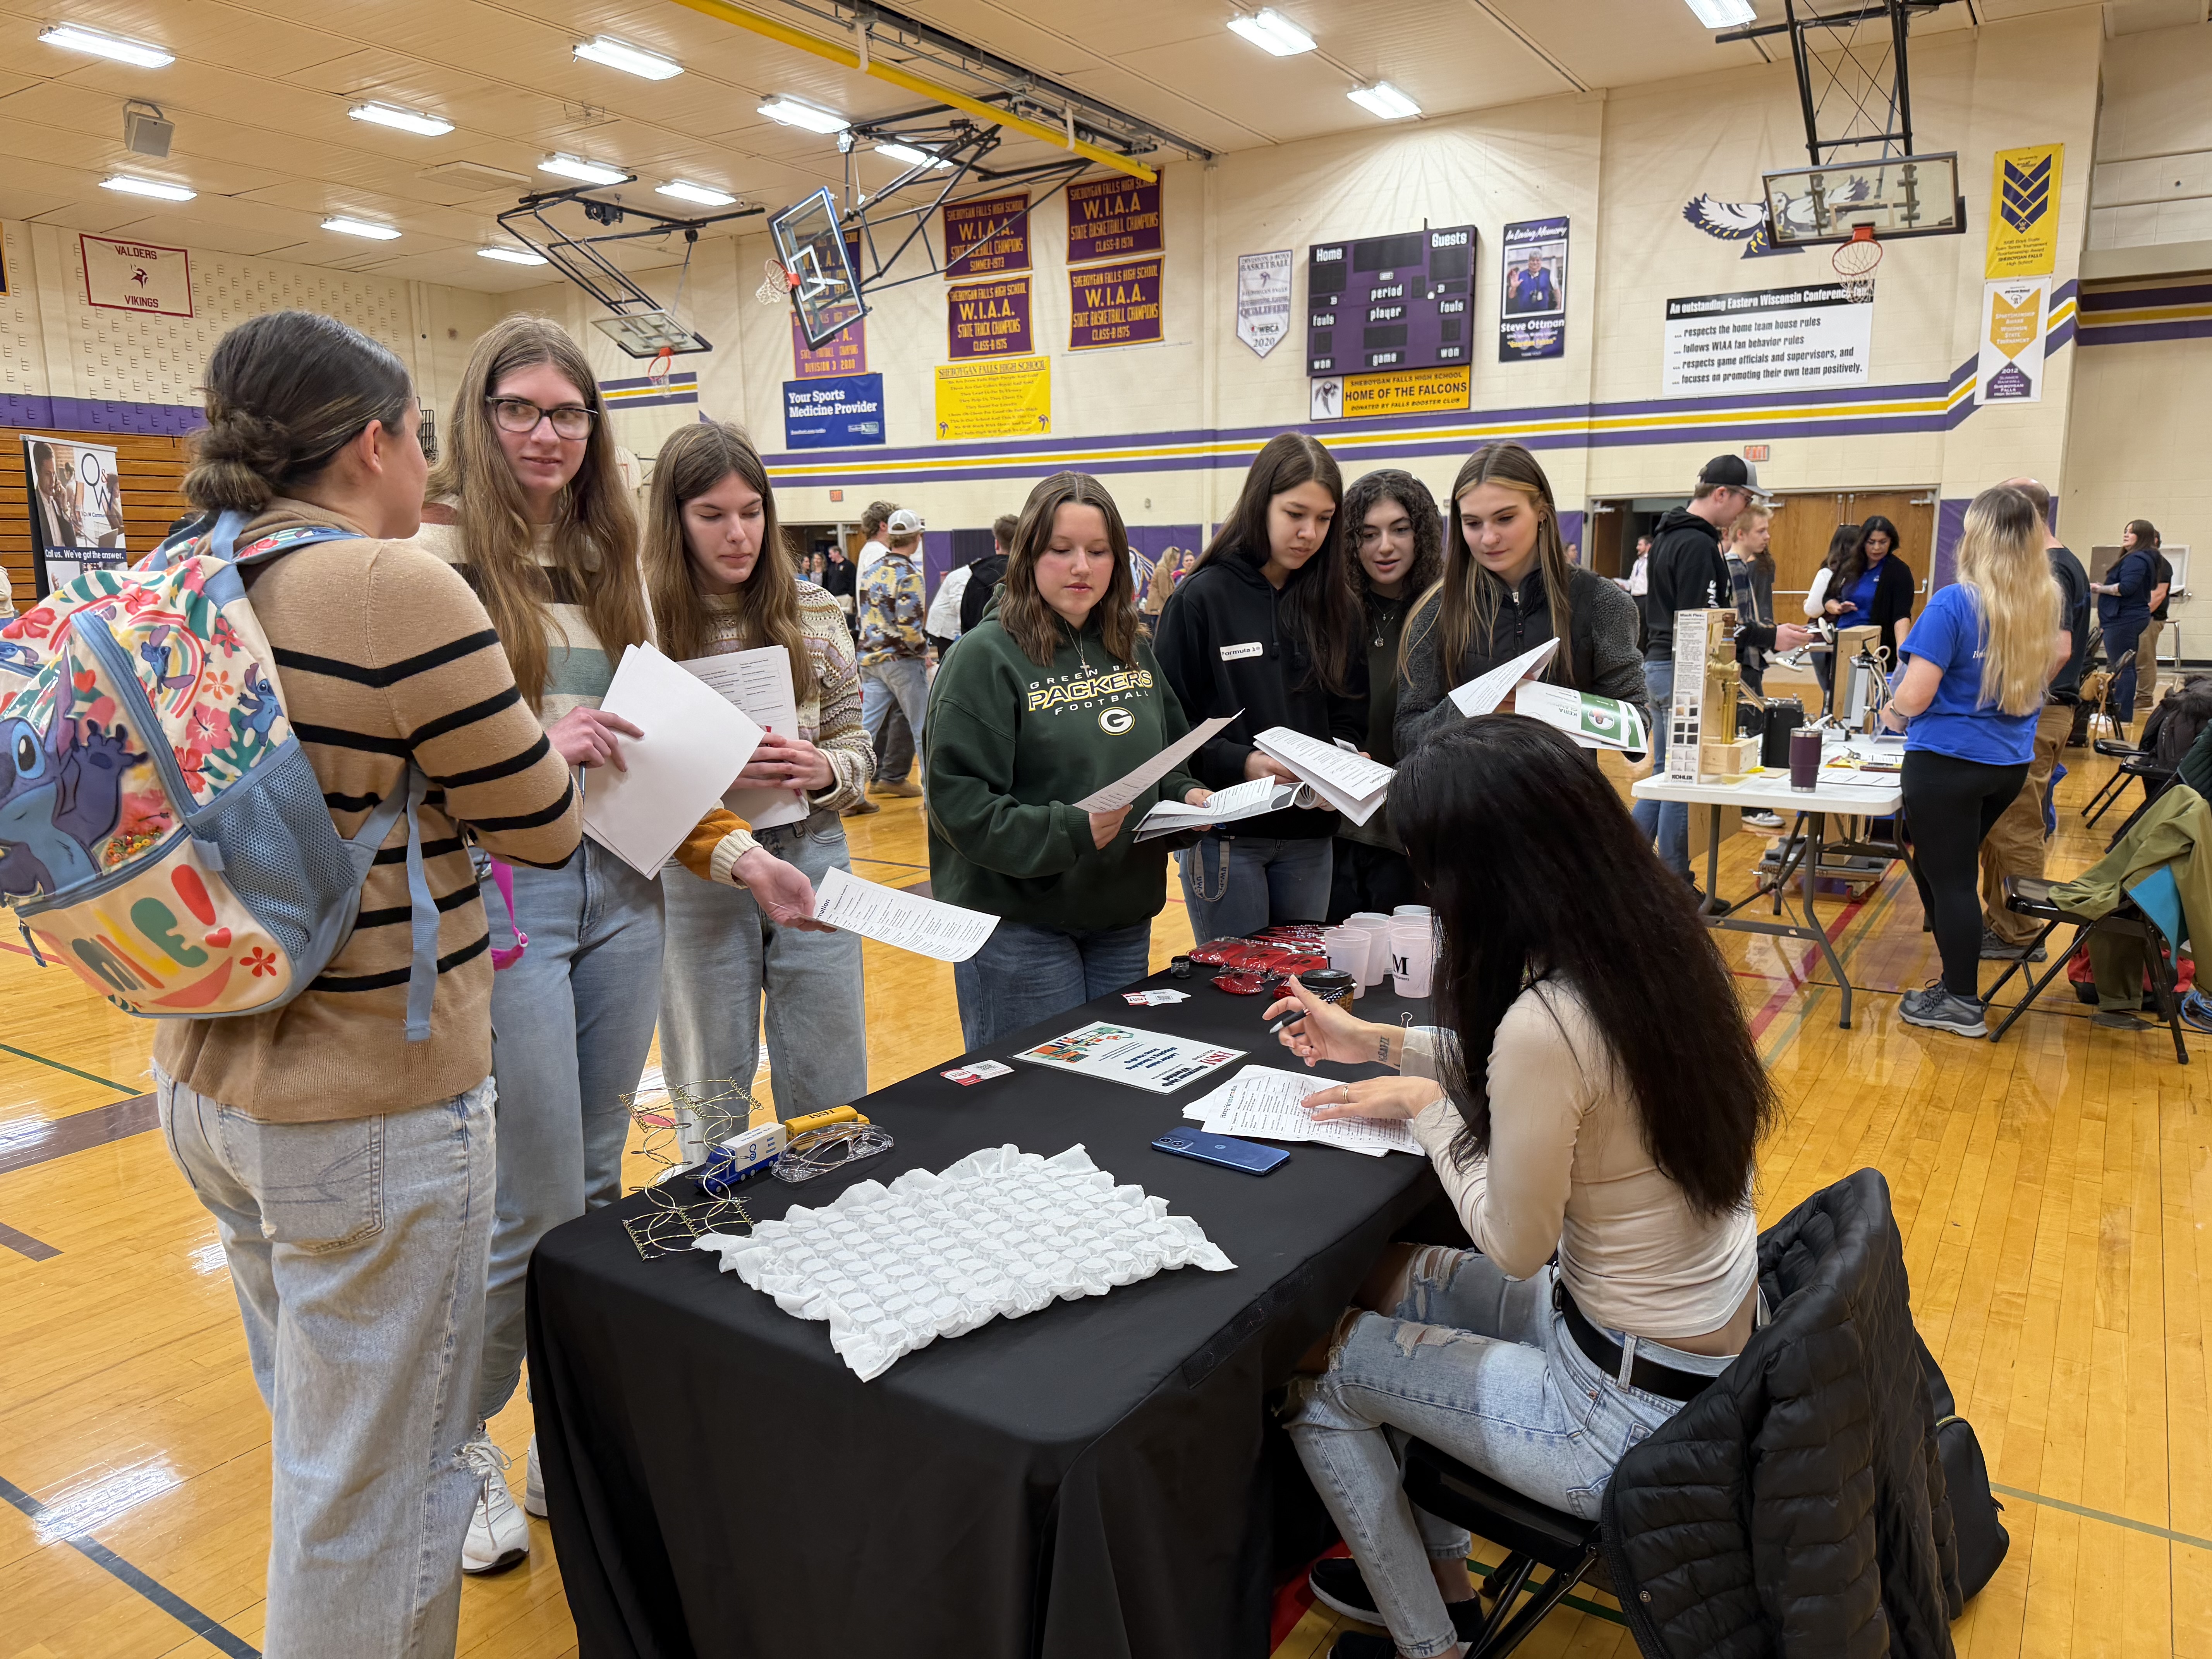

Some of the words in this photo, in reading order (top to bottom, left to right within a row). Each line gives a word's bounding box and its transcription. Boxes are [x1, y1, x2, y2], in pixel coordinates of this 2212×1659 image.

[1103, 181, 1120, 195] FALLS
[1121, 179, 1135, 192] HIGH
[975, 204, 992, 217] FALLS
[993, 203, 1005, 215] HIGH
[1005, 200, 1025, 213] SCHOOL
[958, 218, 1014, 241] W.I.A.A.
[1071, 224, 1087, 240] STATE
[1089, 218, 1125, 238] BASKETBALL
[1127, 212, 1158, 231] CHAMPIONS
[994, 237, 1023, 254] CHAMPIONS
[1432, 232, 1467, 247] Guests
[115, 245, 157, 260] VALDERS
[1316, 247, 1343, 263] Home
[1072, 273, 1104, 287] SHEBOYGAN
[1104, 271, 1122, 283] FALLS
[1123, 268, 1136, 281] HIGH
[1137, 265, 1158, 279] SCHOOL
[950, 289, 977, 302] SHEBOYGAN
[978, 288, 994, 299] FALLS
[994, 285, 1006, 297] HIGH
[1007, 282, 1027, 296] SCHOOL
[1085, 283, 1146, 308] W.I.A.A.
[1371, 283, 1403, 302] period
[124, 295, 158, 308] VIKINGS
[959, 299, 1015, 321] W.I.A.A.
[1440, 299, 1464, 313] fouls
[1670, 303, 1680, 314] An
[1682, 299, 1726, 313] outstanding
[1727, 296, 1758, 309] Eastern
[1760, 292, 1802, 306] Wisconsin
[1073, 312, 1089, 328] STATE
[1090, 308, 1126, 326] BASKETBALL
[1127, 302, 1159, 321] CHAMPIONS
[1313, 313, 1334, 326] fouls
[1370, 306, 1402, 322] player
[957, 323, 974, 338] STATE
[991, 318, 1021, 335] CHAMPIONS
[1501, 322, 1527, 333] Steve
[1527, 319, 1565, 330] Ottman
[1684, 326, 1716, 338] respects
[1719, 325, 1730, 334] the
[1732, 323, 1752, 333] home
[1755, 321, 1772, 331] team
[1775, 319, 1798, 330] house
[1800, 317, 1821, 328] rules
[1254, 338, 1275, 347] 2020
[1683, 343, 1709, 354] follows
[1712, 340, 1732, 351] WIAA
[1735, 340, 1746, 350] fan
[1748, 337, 1781, 349] behavior
[1783, 335, 1805, 345] rules
[1372, 352, 1397, 366] game
[1441, 347, 1460, 358] won
[1682, 358, 1714, 369] respects
[1717, 358, 1736, 368] game
[1739, 354, 1769, 364] officials
[1771, 352, 1784, 362] and
[1787, 349, 1837, 362] supervisors,
[1839, 347, 1854, 357] and
[1314, 359, 1331, 369] won
[1682, 374, 1709, 384] focuses
[1712, 373, 1721, 382] on
[1723, 369, 1760, 383] promoting
[1763, 369, 1781, 378] their
[1784, 369, 1799, 377] own
[1802, 366, 1820, 376] team
[1823, 362, 1863, 376] positively.
[1351, 378, 1391, 387] SHEBOYGAN
[788, 392, 811, 404] Your
[812, 389, 845, 403] Sports
[1345, 391, 1374, 402] HOME
[1377, 388, 1391, 399] OF
[1395, 386, 1415, 397] THE
[1419, 382, 1467, 395] FALCONS
[789, 404, 833, 418] Medicine
[834, 400, 878, 414] Provider
[45, 549, 53, 558] Call
[64, 549, 82, 558] We've
[83, 550, 91, 560] got
[92, 550, 101, 559] the
[1030, 669, 1098, 689] GREEN
[1028, 670, 1153, 711] PACKERS
[1055, 690, 1149, 715] FOOTBALL
[1099, 707, 1135, 735] G
[1197, 1051, 1237, 1065] HSM
[1161, 1067, 1193, 1081] Wanted
[808, 1109, 836, 1119] HSM
